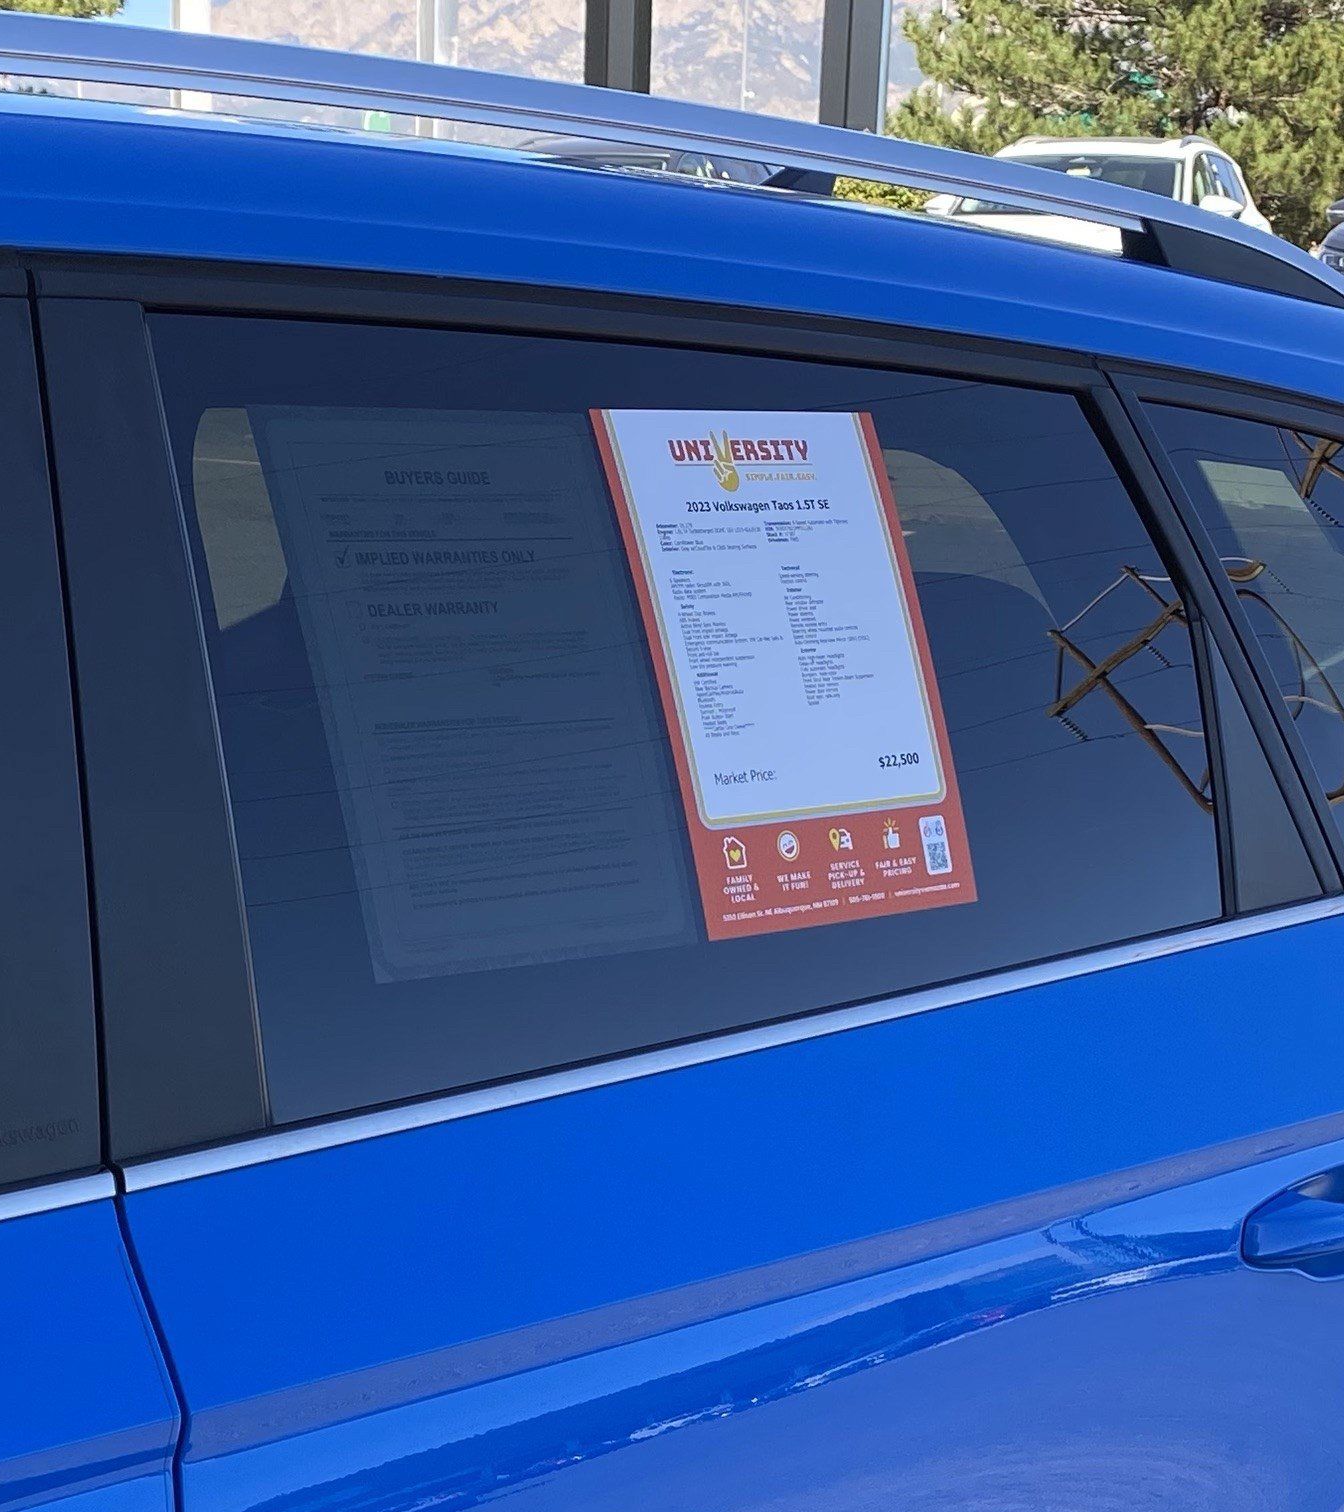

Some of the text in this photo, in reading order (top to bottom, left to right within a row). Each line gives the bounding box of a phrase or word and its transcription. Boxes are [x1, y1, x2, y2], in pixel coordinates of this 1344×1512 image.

[668, 431, 808, 462] UNIVERSITY
[384, 470, 491, 486] BUYERS GUIDE
[686, 499, 830, 514] 2023 Volkswagen Taos 1.5T SE
[356, 550, 536, 566] IMPLIED WARRANTIES ONLY
[367, 601, 498, 618] DEALER WARRANTY
[714, 752, 920, 786] Market Price: $22,500
[830, 860, 860, 872] SERVICE
[875, 857, 917, 869] FAIR & EASY
[777, 871, 811, 883] WE MAKE
[828, 869, 859, 881] PICK-UP
[883, 866, 912, 878] PRICING
[726, 874, 753, 885] FAMILY
[832, 878, 865, 890] DELIVERY
[723, 884, 752, 895] OWNED
[782, 882, 791, 891] IT
[731, 893, 756, 904] LOCAL
